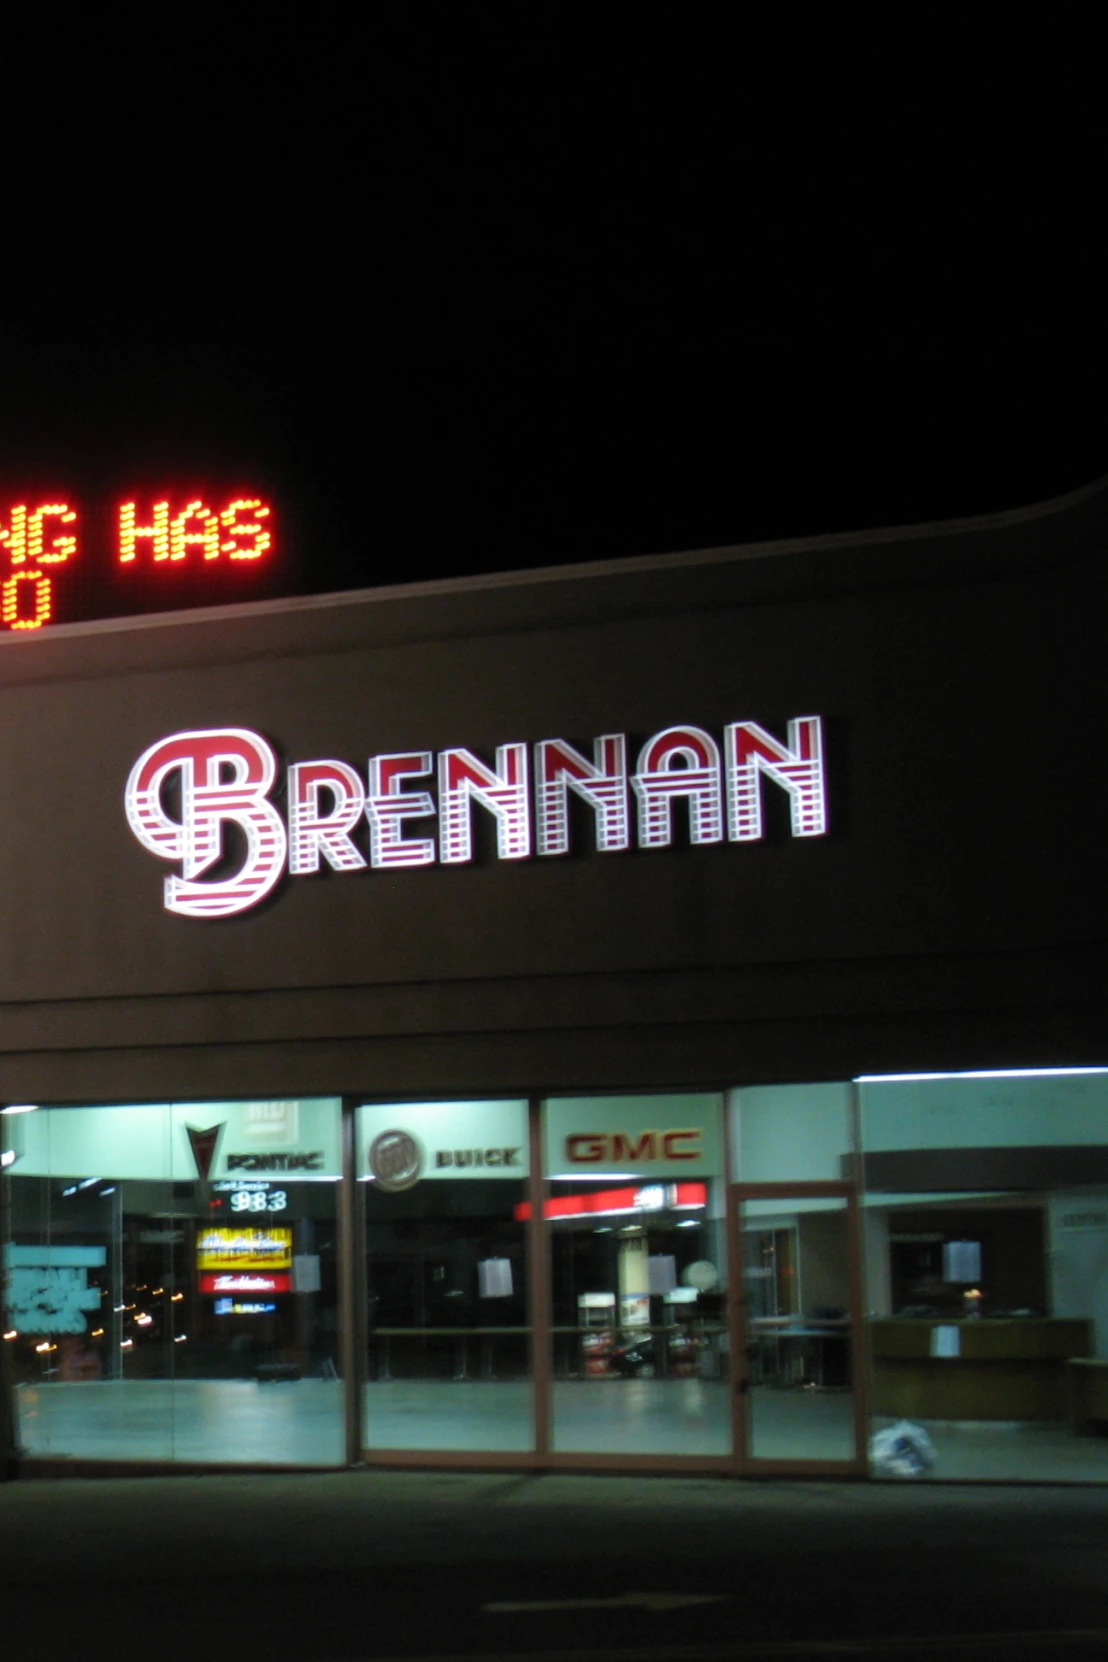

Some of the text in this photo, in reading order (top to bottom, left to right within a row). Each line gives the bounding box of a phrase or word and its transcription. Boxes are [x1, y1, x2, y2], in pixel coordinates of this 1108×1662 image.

[119, 499, 271, 563] HAS
[124, 716, 827, 918] BRENNAN
[227, 1151, 324, 1171] PONTIAC
[435, 1147, 523, 1168] BUICK
[566, 1130, 703, 1163] GMC
